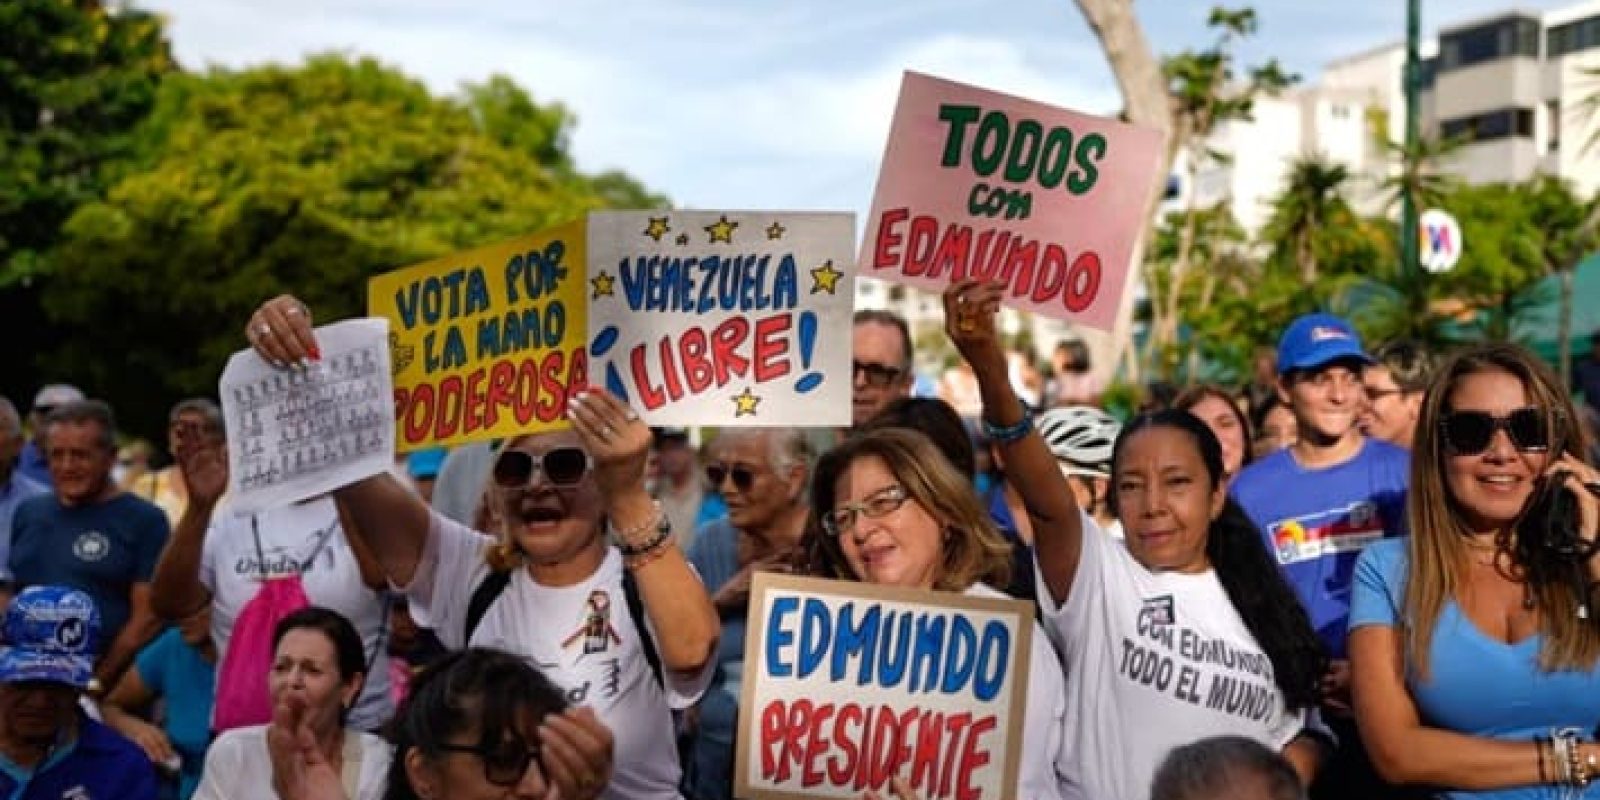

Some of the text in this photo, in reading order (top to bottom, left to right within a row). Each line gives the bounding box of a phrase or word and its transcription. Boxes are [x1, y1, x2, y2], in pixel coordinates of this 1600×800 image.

[939, 104, 1107, 195] TODOS
[396, 240, 567, 330] VOTA POR
[619, 253, 797, 315] VENEZUELA
[873, 208, 1101, 312] EDMUNDO
[424, 300, 565, 374] LA MANO
[767, 597, 1009, 701] EDMUNDO
[1121, 637, 1174, 692] TODO
[1174, 664, 1201, 705] EL
[761, 699, 997, 800] PRESIDENTE
